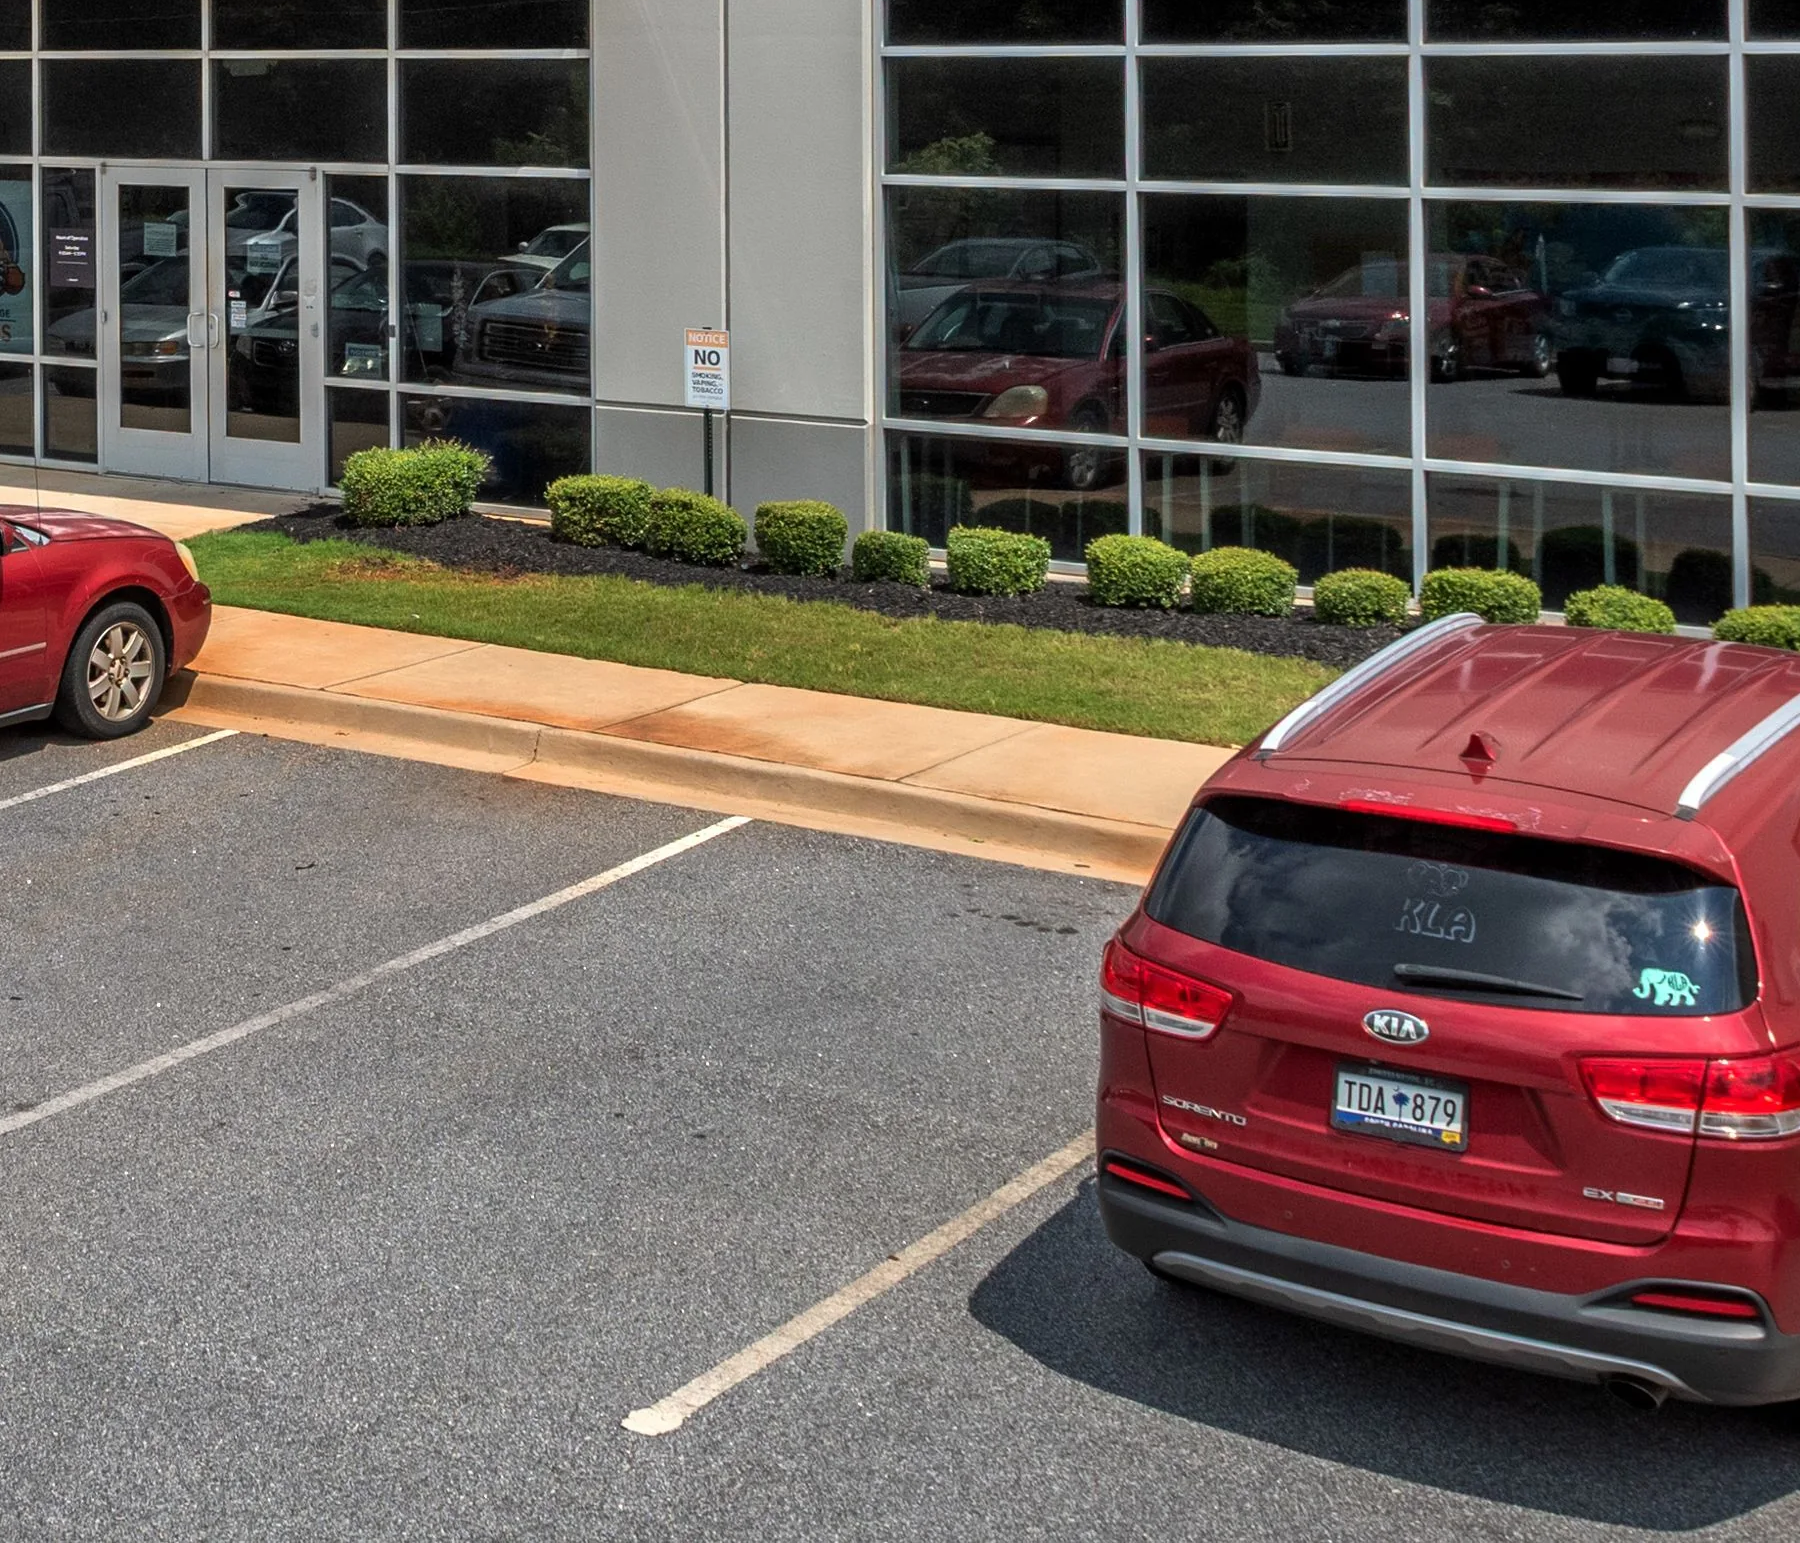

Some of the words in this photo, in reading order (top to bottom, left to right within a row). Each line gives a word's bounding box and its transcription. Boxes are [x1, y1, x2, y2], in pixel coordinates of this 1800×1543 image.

[688, 332, 726, 344] NOTICE
[694, 350, 721, 366] NO
[692, 386, 724, 395] TOBACCO
[1373, 1014, 1418, 1039] KIA
[1162, 1095, 1247, 1126] SORENTO
[1344, 1080, 1385, 1115] TDA
[1412, 1093, 1456, 1127] 879
[1583, 1186, 1614, 1201] EX
